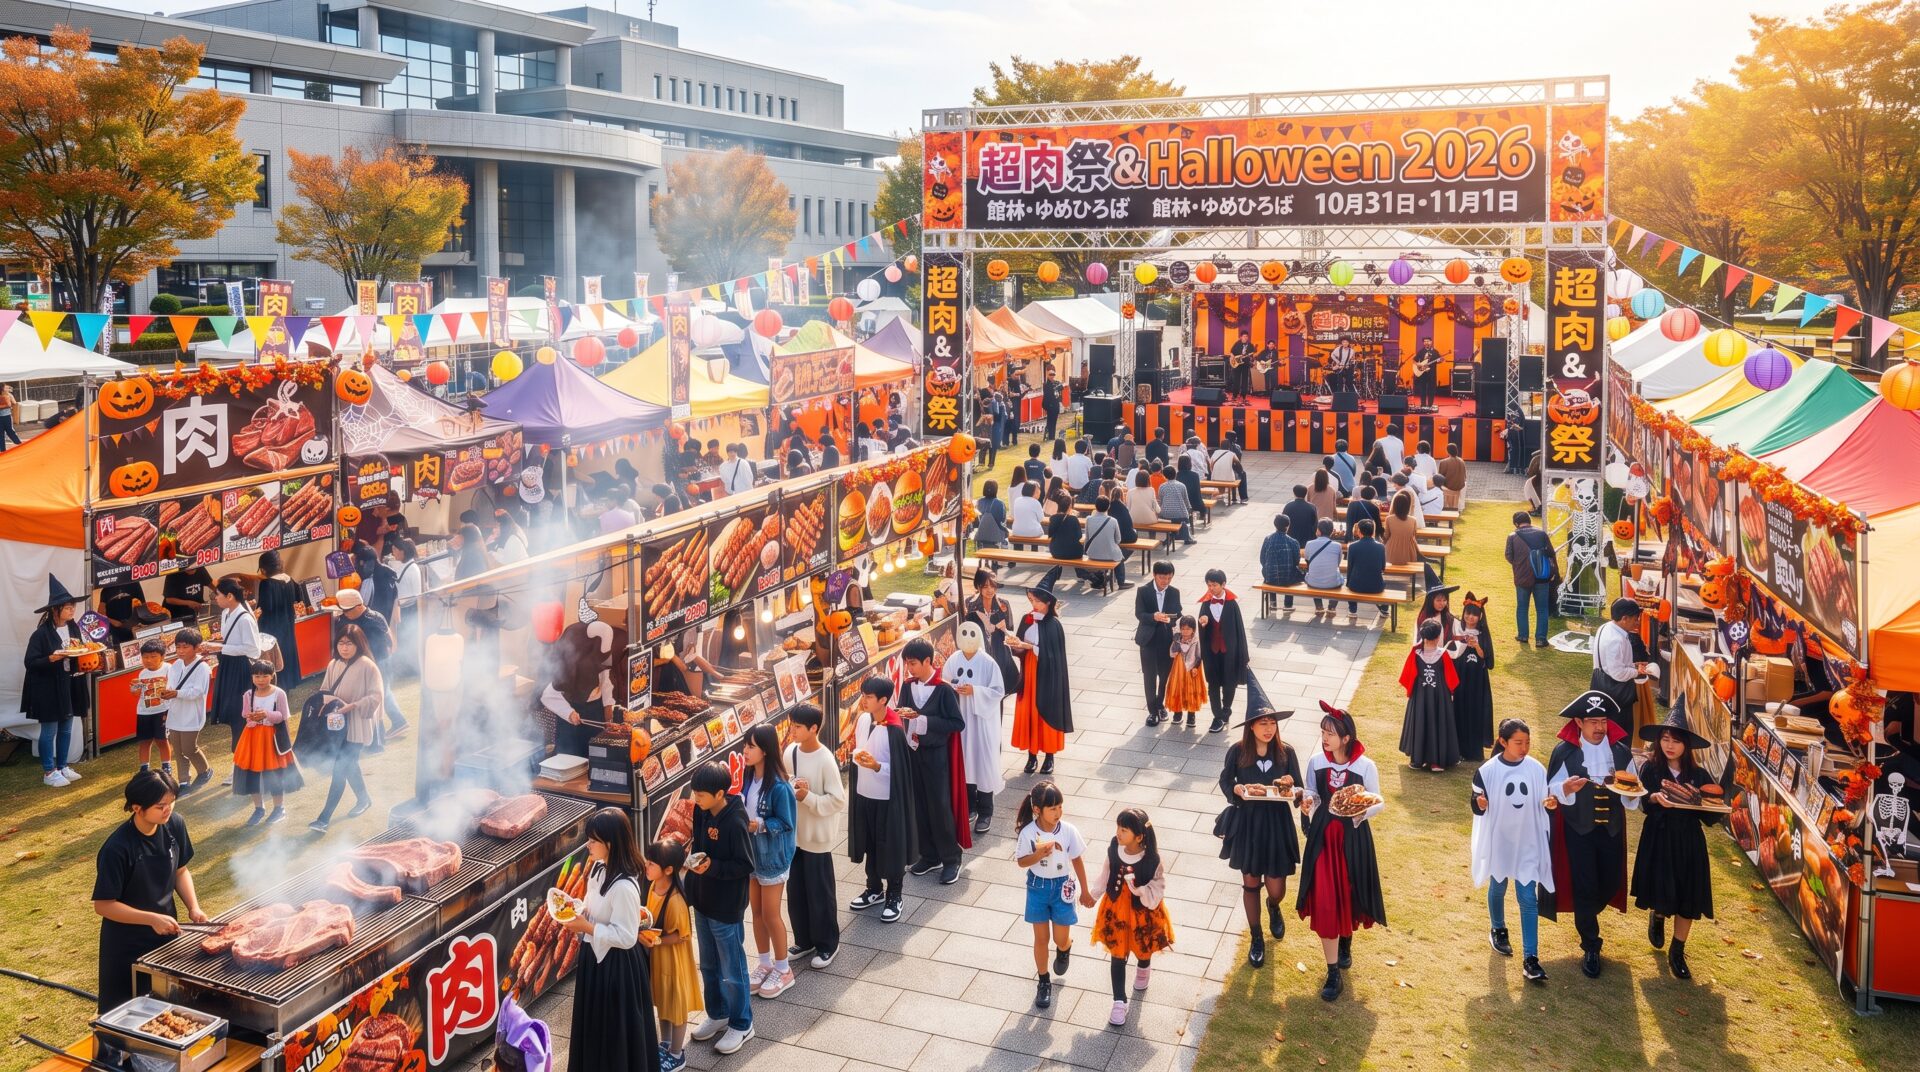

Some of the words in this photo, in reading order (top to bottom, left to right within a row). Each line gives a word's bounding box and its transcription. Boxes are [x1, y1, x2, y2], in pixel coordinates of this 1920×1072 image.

[978, 133, 1394, 194] 超肉祭&Halloween
[1401, 125, 1536, 183] 2026
[987, 197, 1130, 221] 館林・ゆめひろば
[1152, 193, 1294, 218] 館林・ゆめひろば
[1315, 188, 1518, 215] 10月31日・11月1日
[163, 396, 229, 475] 肉
[414, 453, 440, 488] 肉
[511, 898, 527, 930] 肉
[426, 932, 499, 1066] 肉
